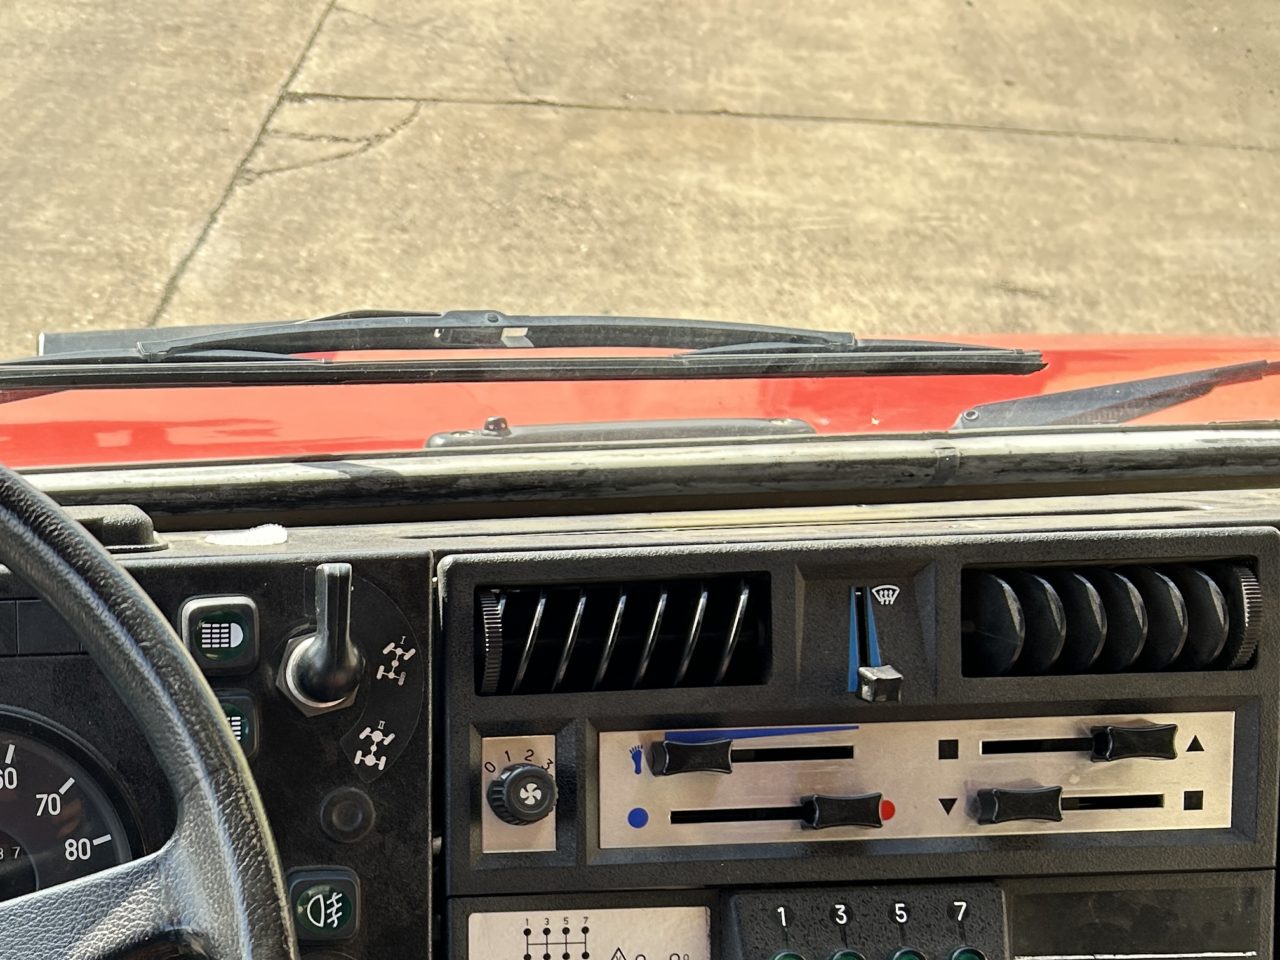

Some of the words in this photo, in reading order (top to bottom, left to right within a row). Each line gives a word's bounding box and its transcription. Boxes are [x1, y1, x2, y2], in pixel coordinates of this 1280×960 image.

[504, 750, 511, 762] 1
[524, 748, 535, 762] 2
[484, 761, 496, 773] 0
[35, 793, 61, 817] 70
[64, 838, 91, 861] 80
[544, 918, 550, 926] 3
[563, 917, 569, 925] 5
[583, 916, 589, 925] 7
[777, 906, 787, 927] 1
[834, 904, 848, 925] 3
[895, 903, 908, 923] 5
[953, 901, 968, 921] 7
